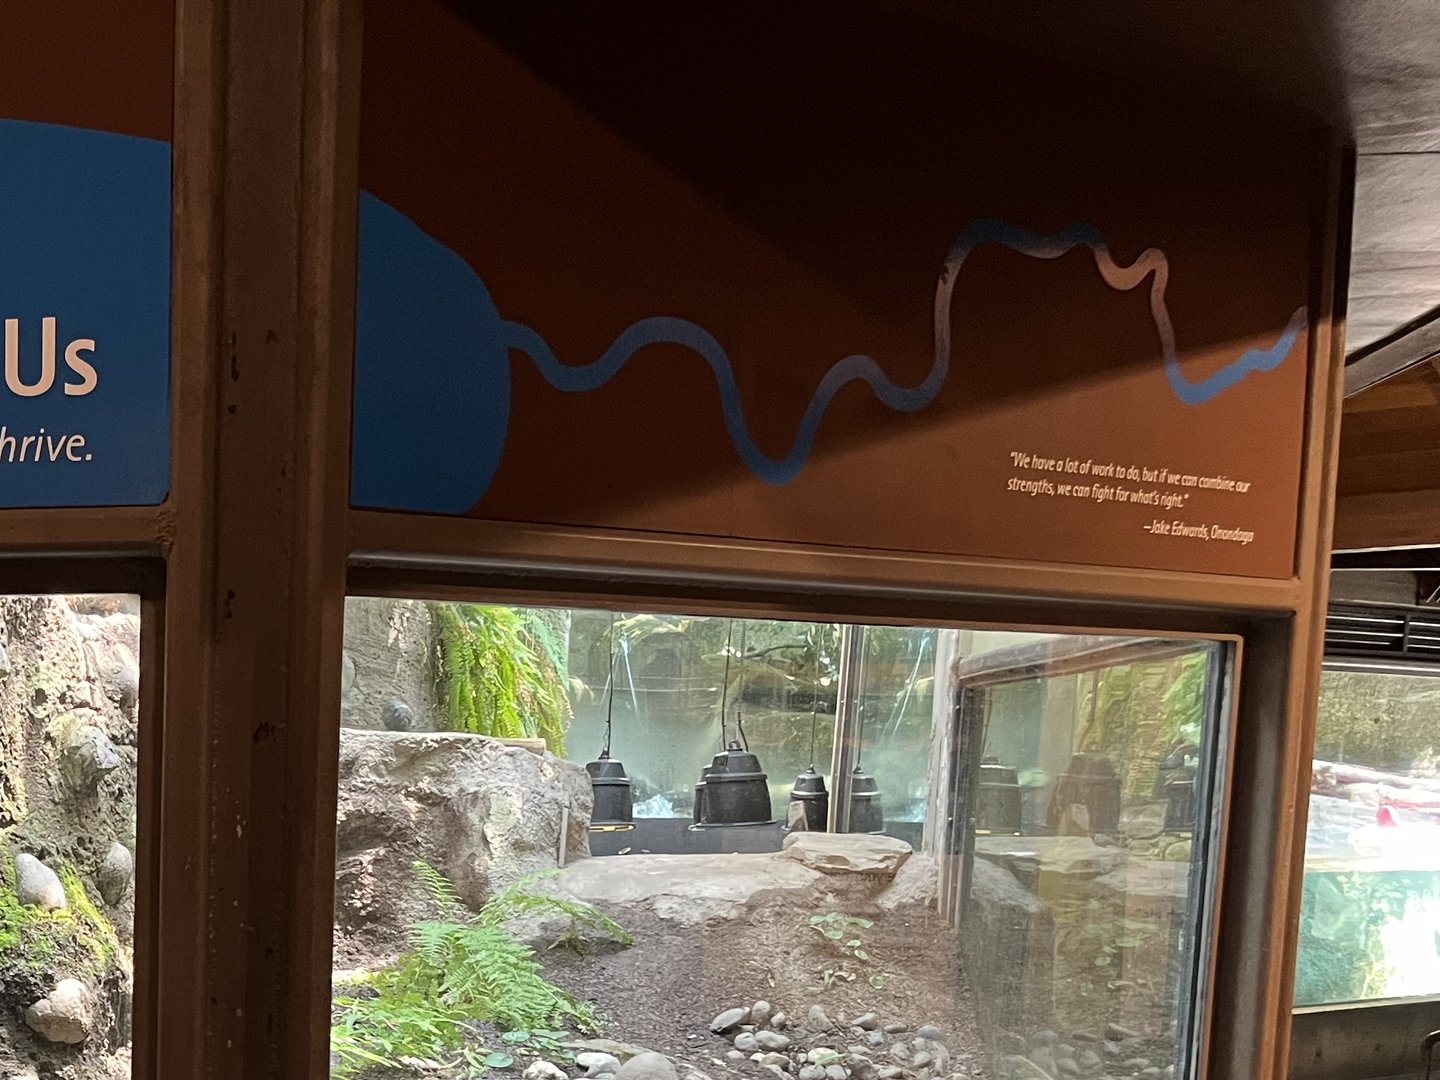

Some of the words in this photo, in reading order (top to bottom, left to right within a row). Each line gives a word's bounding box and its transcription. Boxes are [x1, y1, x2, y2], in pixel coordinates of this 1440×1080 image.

[3, 316, 98, 397] Us
[1031, 454, 1055, 471] have
[1056, 460, 1063, 472] a
[1064, 457, 1079, 474] lot
[1079, 459, 1092, 474] of
[1091, 463, 1115, 477] work
[1115, 465, 1126, 479] to
[1126, 465, 1140, 482] do,
[1142, 466, 1158, 482] but
[1159, 468, 1169, 483] if
[1167, 473, 1180, 485] we
[1181, 475, 1198, 487] can
[1198, 475, 1235, 491] combine
[1235, 481, 1251, 493] our
[1007, 477, 1055, 496] strengths,
[1057, 483, 1071, 496] we
[1072, 484, 1090, 498] can
[1091, 483, 1115, 503] fight
[1115, 486, 1130, 501] for
[1130, 489, 1159, 505] what's
[1171, 521, 1210, 540] Edwards,
